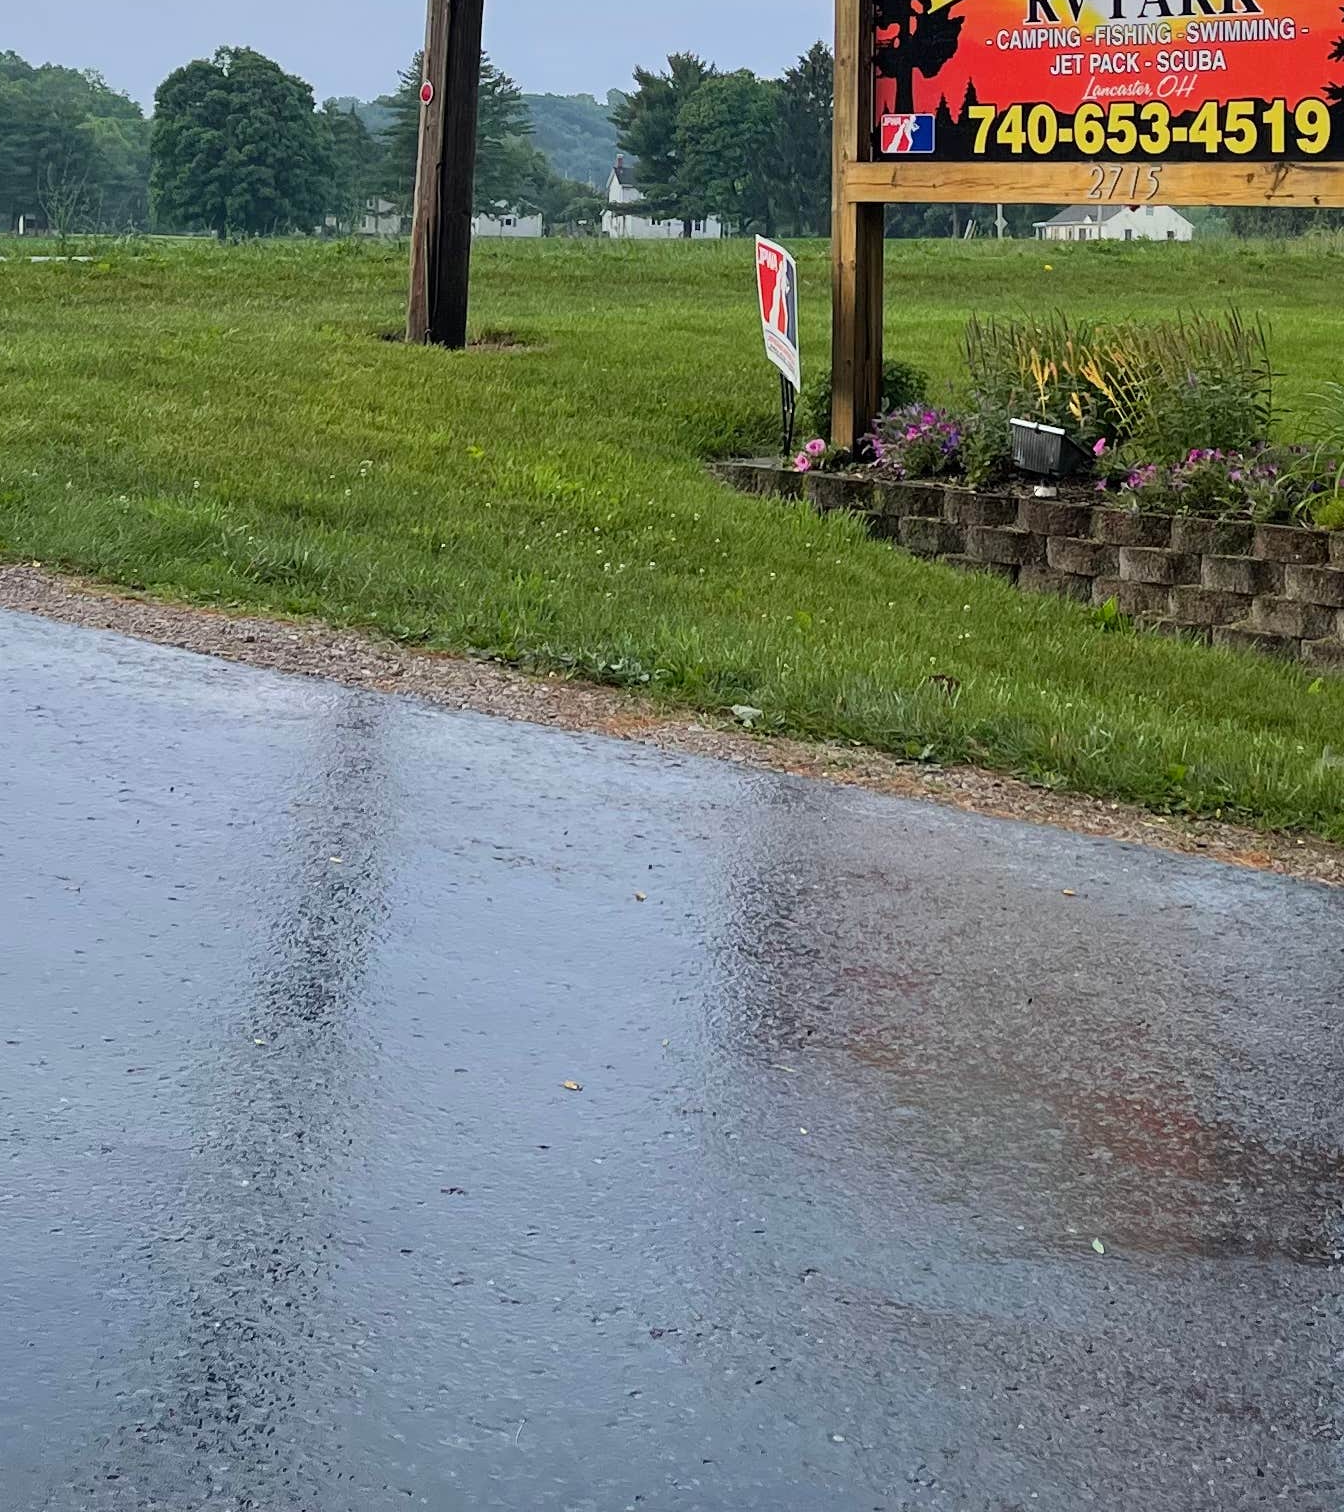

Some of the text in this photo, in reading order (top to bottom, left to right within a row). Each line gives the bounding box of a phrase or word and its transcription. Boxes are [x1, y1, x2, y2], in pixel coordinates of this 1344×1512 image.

[996, 28, 1081, 50] CAMPING
[1050, 54, 1085, 75] JET
[1089, 51, 1141, 74] PACK
[1156, 49, 1227, 73] SCUBA
[1081, 74, 1199, 101] Lancaster, OH
[968, 99, 1332, 156] 740-653-4519
[1087, 164, 1164, 201] 2715
